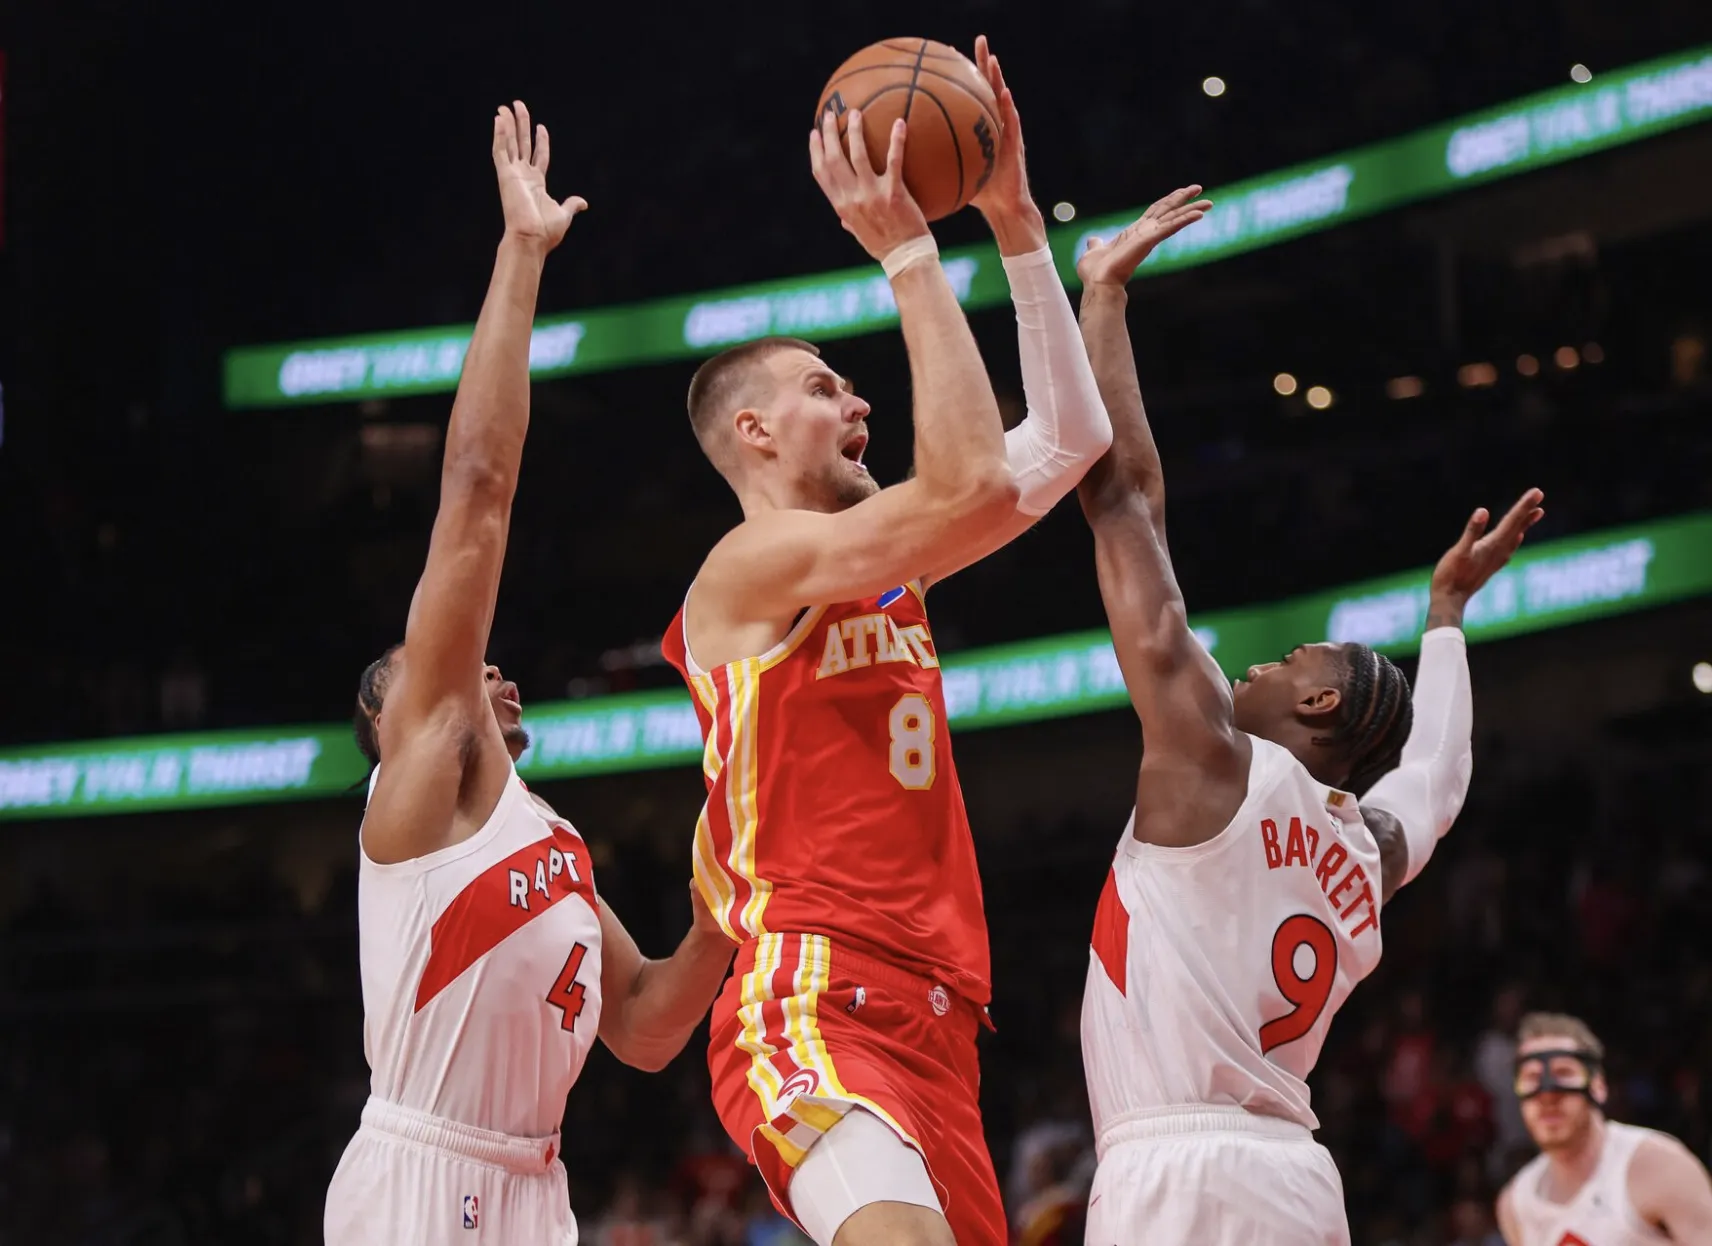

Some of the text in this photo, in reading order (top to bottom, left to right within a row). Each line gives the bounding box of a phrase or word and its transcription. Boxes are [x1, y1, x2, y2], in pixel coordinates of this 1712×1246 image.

[889, 693, 936, 790] 8
[508, 847, 599, 912] RAPT
[546, 941, 588, 1033] 4
[1259, 914, 1337, 1057] 9
